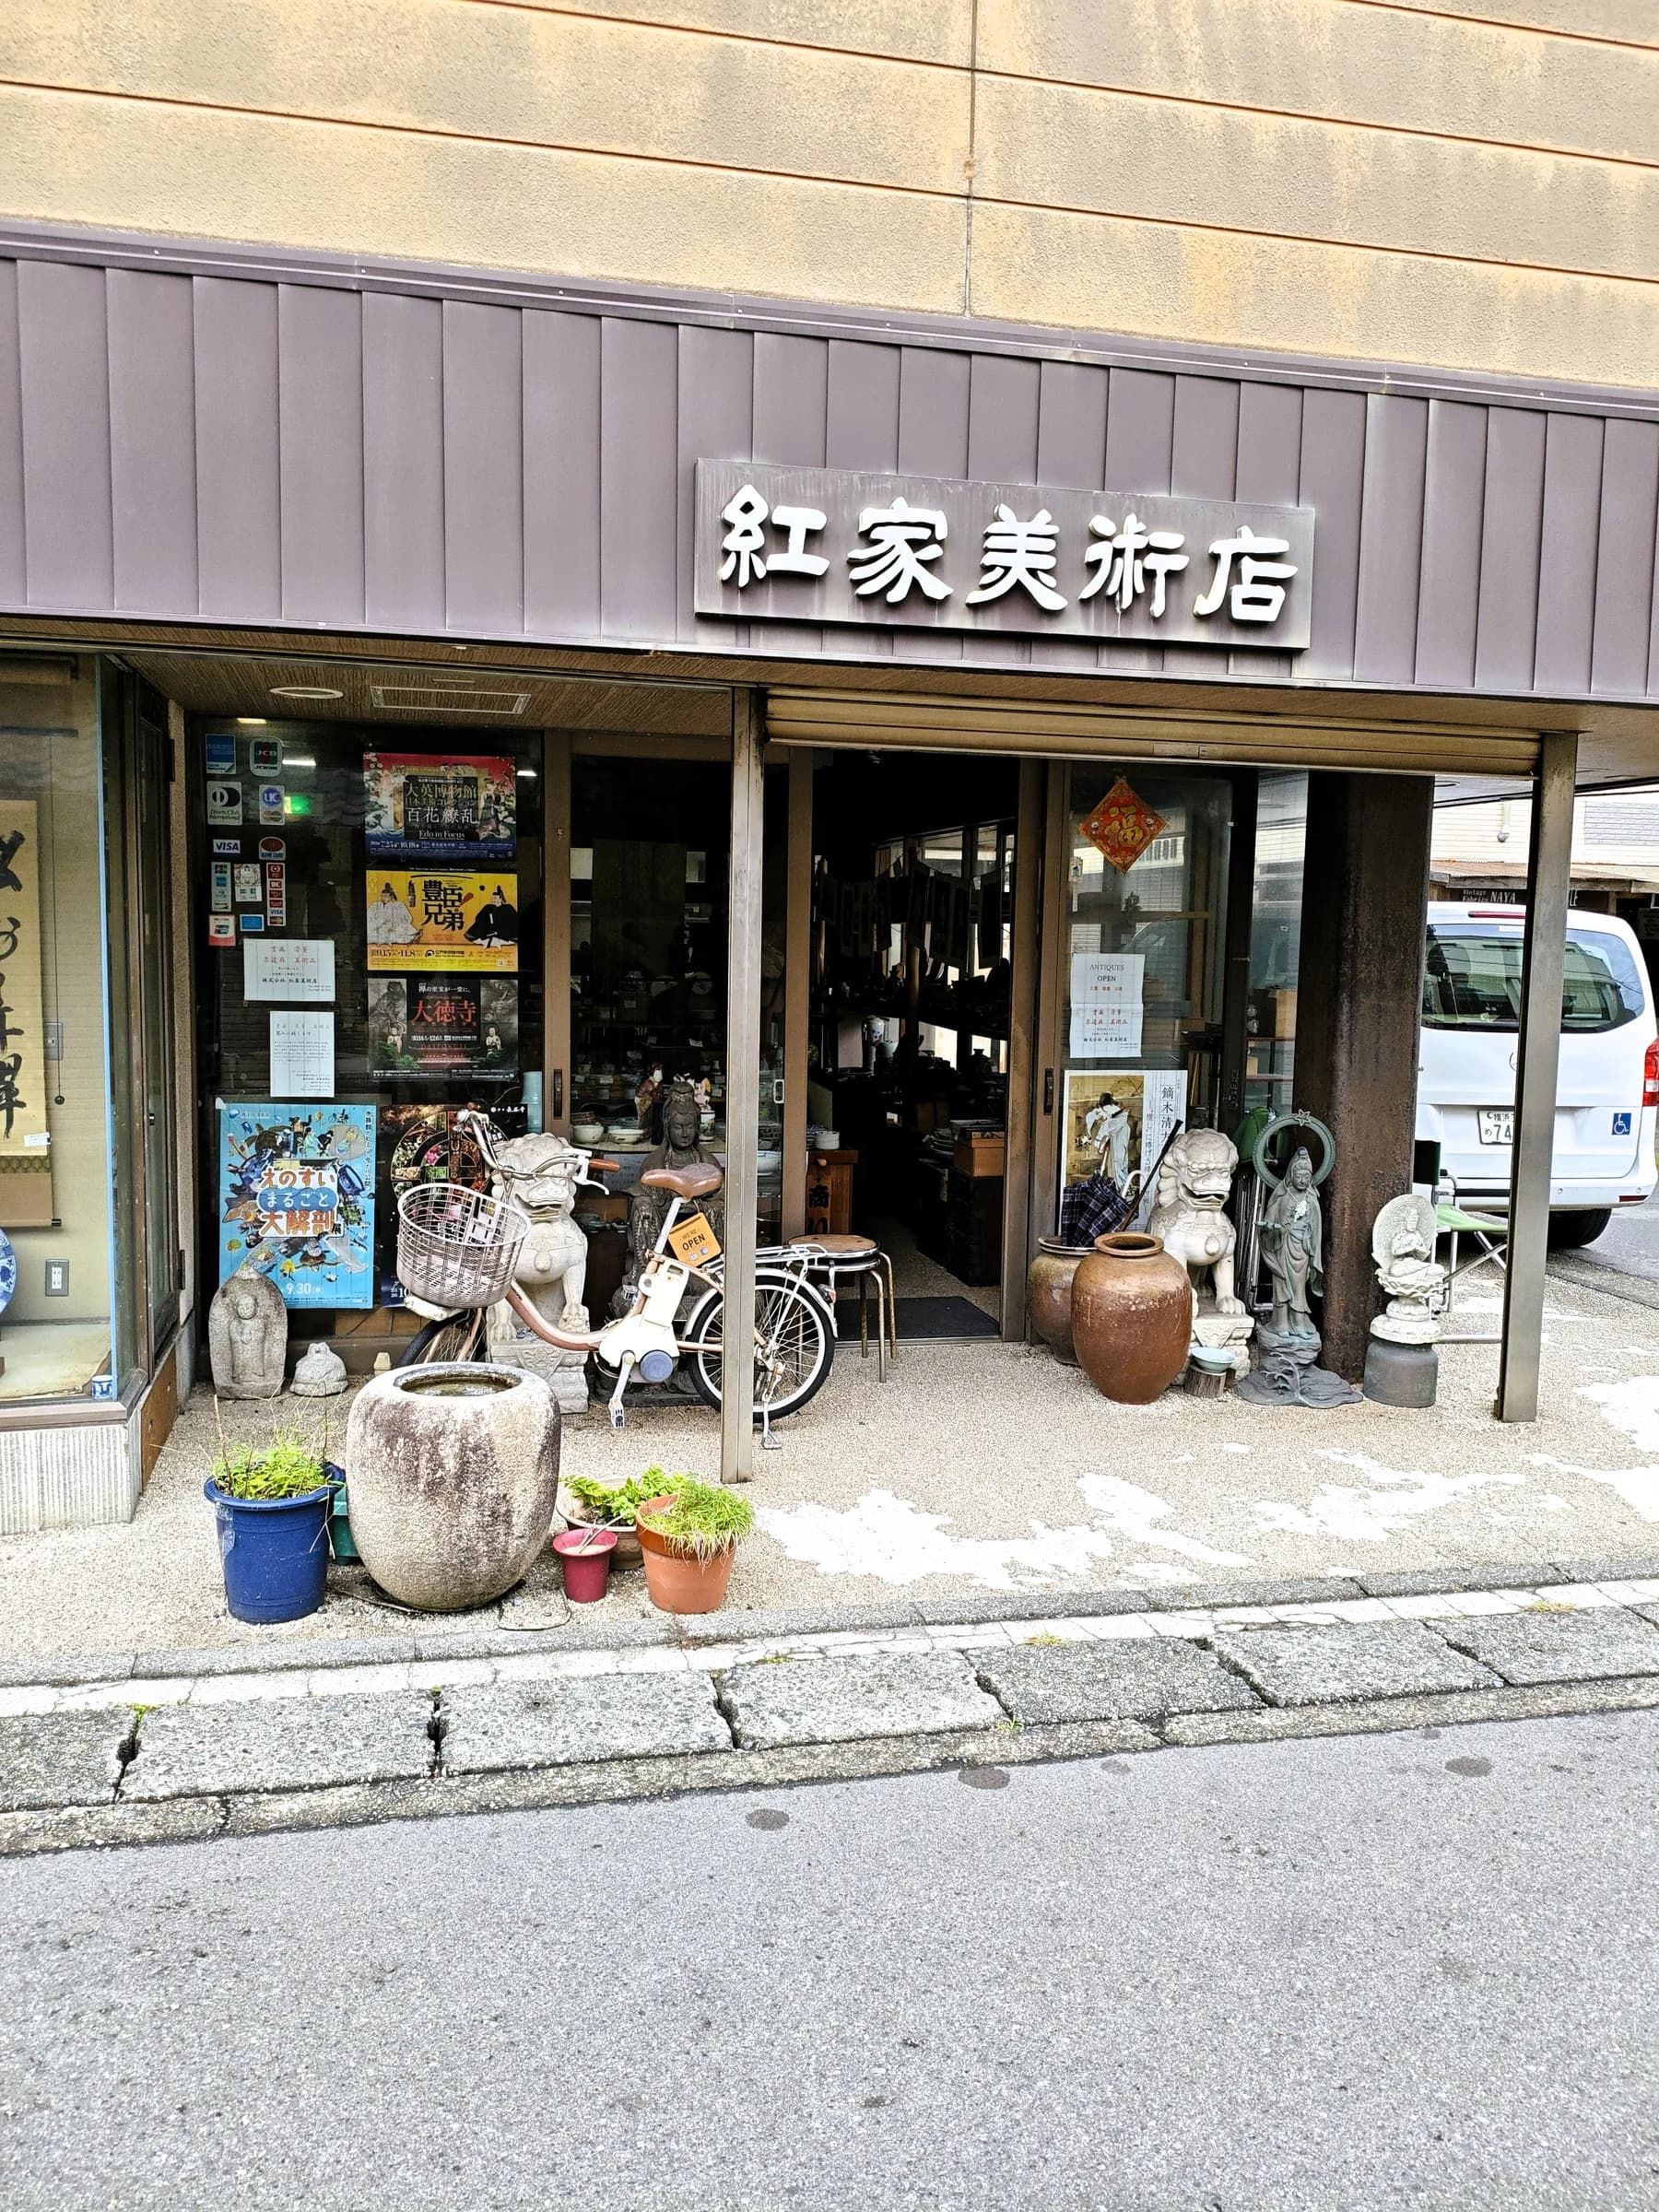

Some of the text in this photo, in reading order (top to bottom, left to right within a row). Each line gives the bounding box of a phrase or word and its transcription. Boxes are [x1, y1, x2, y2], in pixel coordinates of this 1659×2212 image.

[720, 485, 1298, 623] 紅家美術店
[264, 794, 280, 803] UC
[406, 783, 477, 799] 大英博物館
[406, 806, 480, 824] 百花繚乱
[216, 842, 240, 851] VISA
[1489, 891, 1516, 903] NAYA
[412, 1000, 477, 1023] 大徳寺
[261, 1168, 335, 1189] えのすい
[265, 1192, 330, 1208] まるごと
[682, 1233, 706, 1252] OPEN
